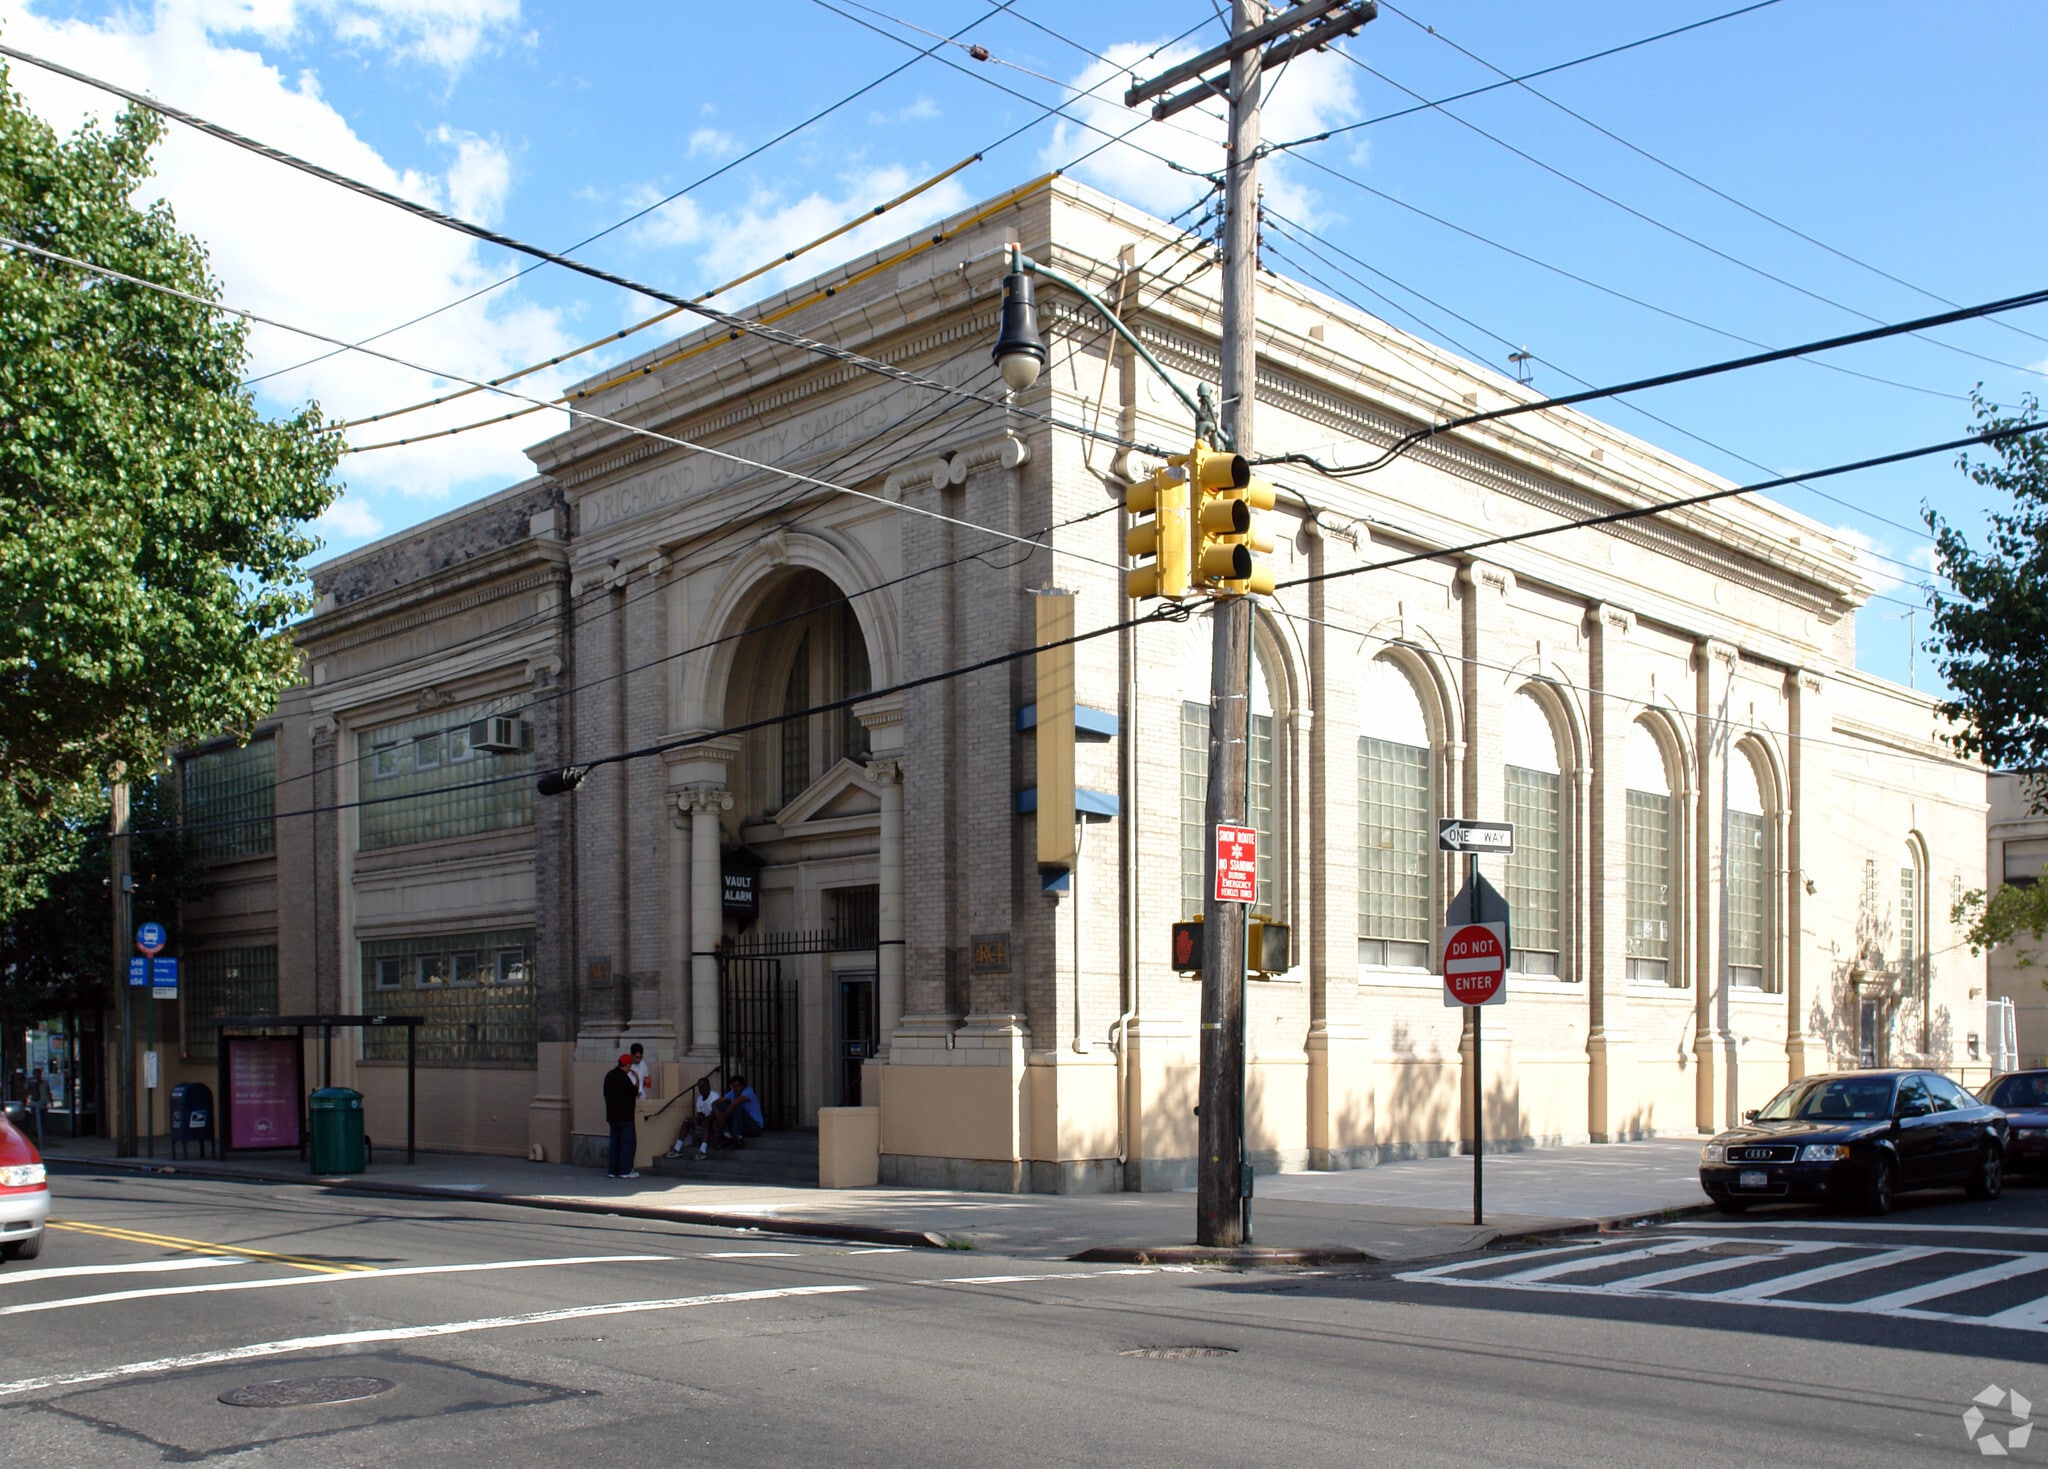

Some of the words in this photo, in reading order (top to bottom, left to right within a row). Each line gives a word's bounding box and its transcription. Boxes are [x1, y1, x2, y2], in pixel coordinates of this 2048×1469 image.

[603, 466, 694, 521] RICHMOND
[801, 394, 889, 452] SAVINGS
[1219, 830, 1235, 842] SNOW
[1238, 832, 1254, 844] ROUTE
[1449, 829, 1470, 842] ONE
[1484, 831, 1504, 844] WAY
[1219, 858, 1228, 870] NO
[1230, 860, 1254, 872] STANDING
[725, 875, 752, 888] VAULT
[1228, 871, 1246, 880] DURING
[1222, 878, 1251, 889] EMERGENCY
[725, 889, 752, 901] ALARM
[1452, 942, 1467, 955] DO
[1472, 939, 1494, 953] NOT
[1455, 976, 1492, 991] ENTER
